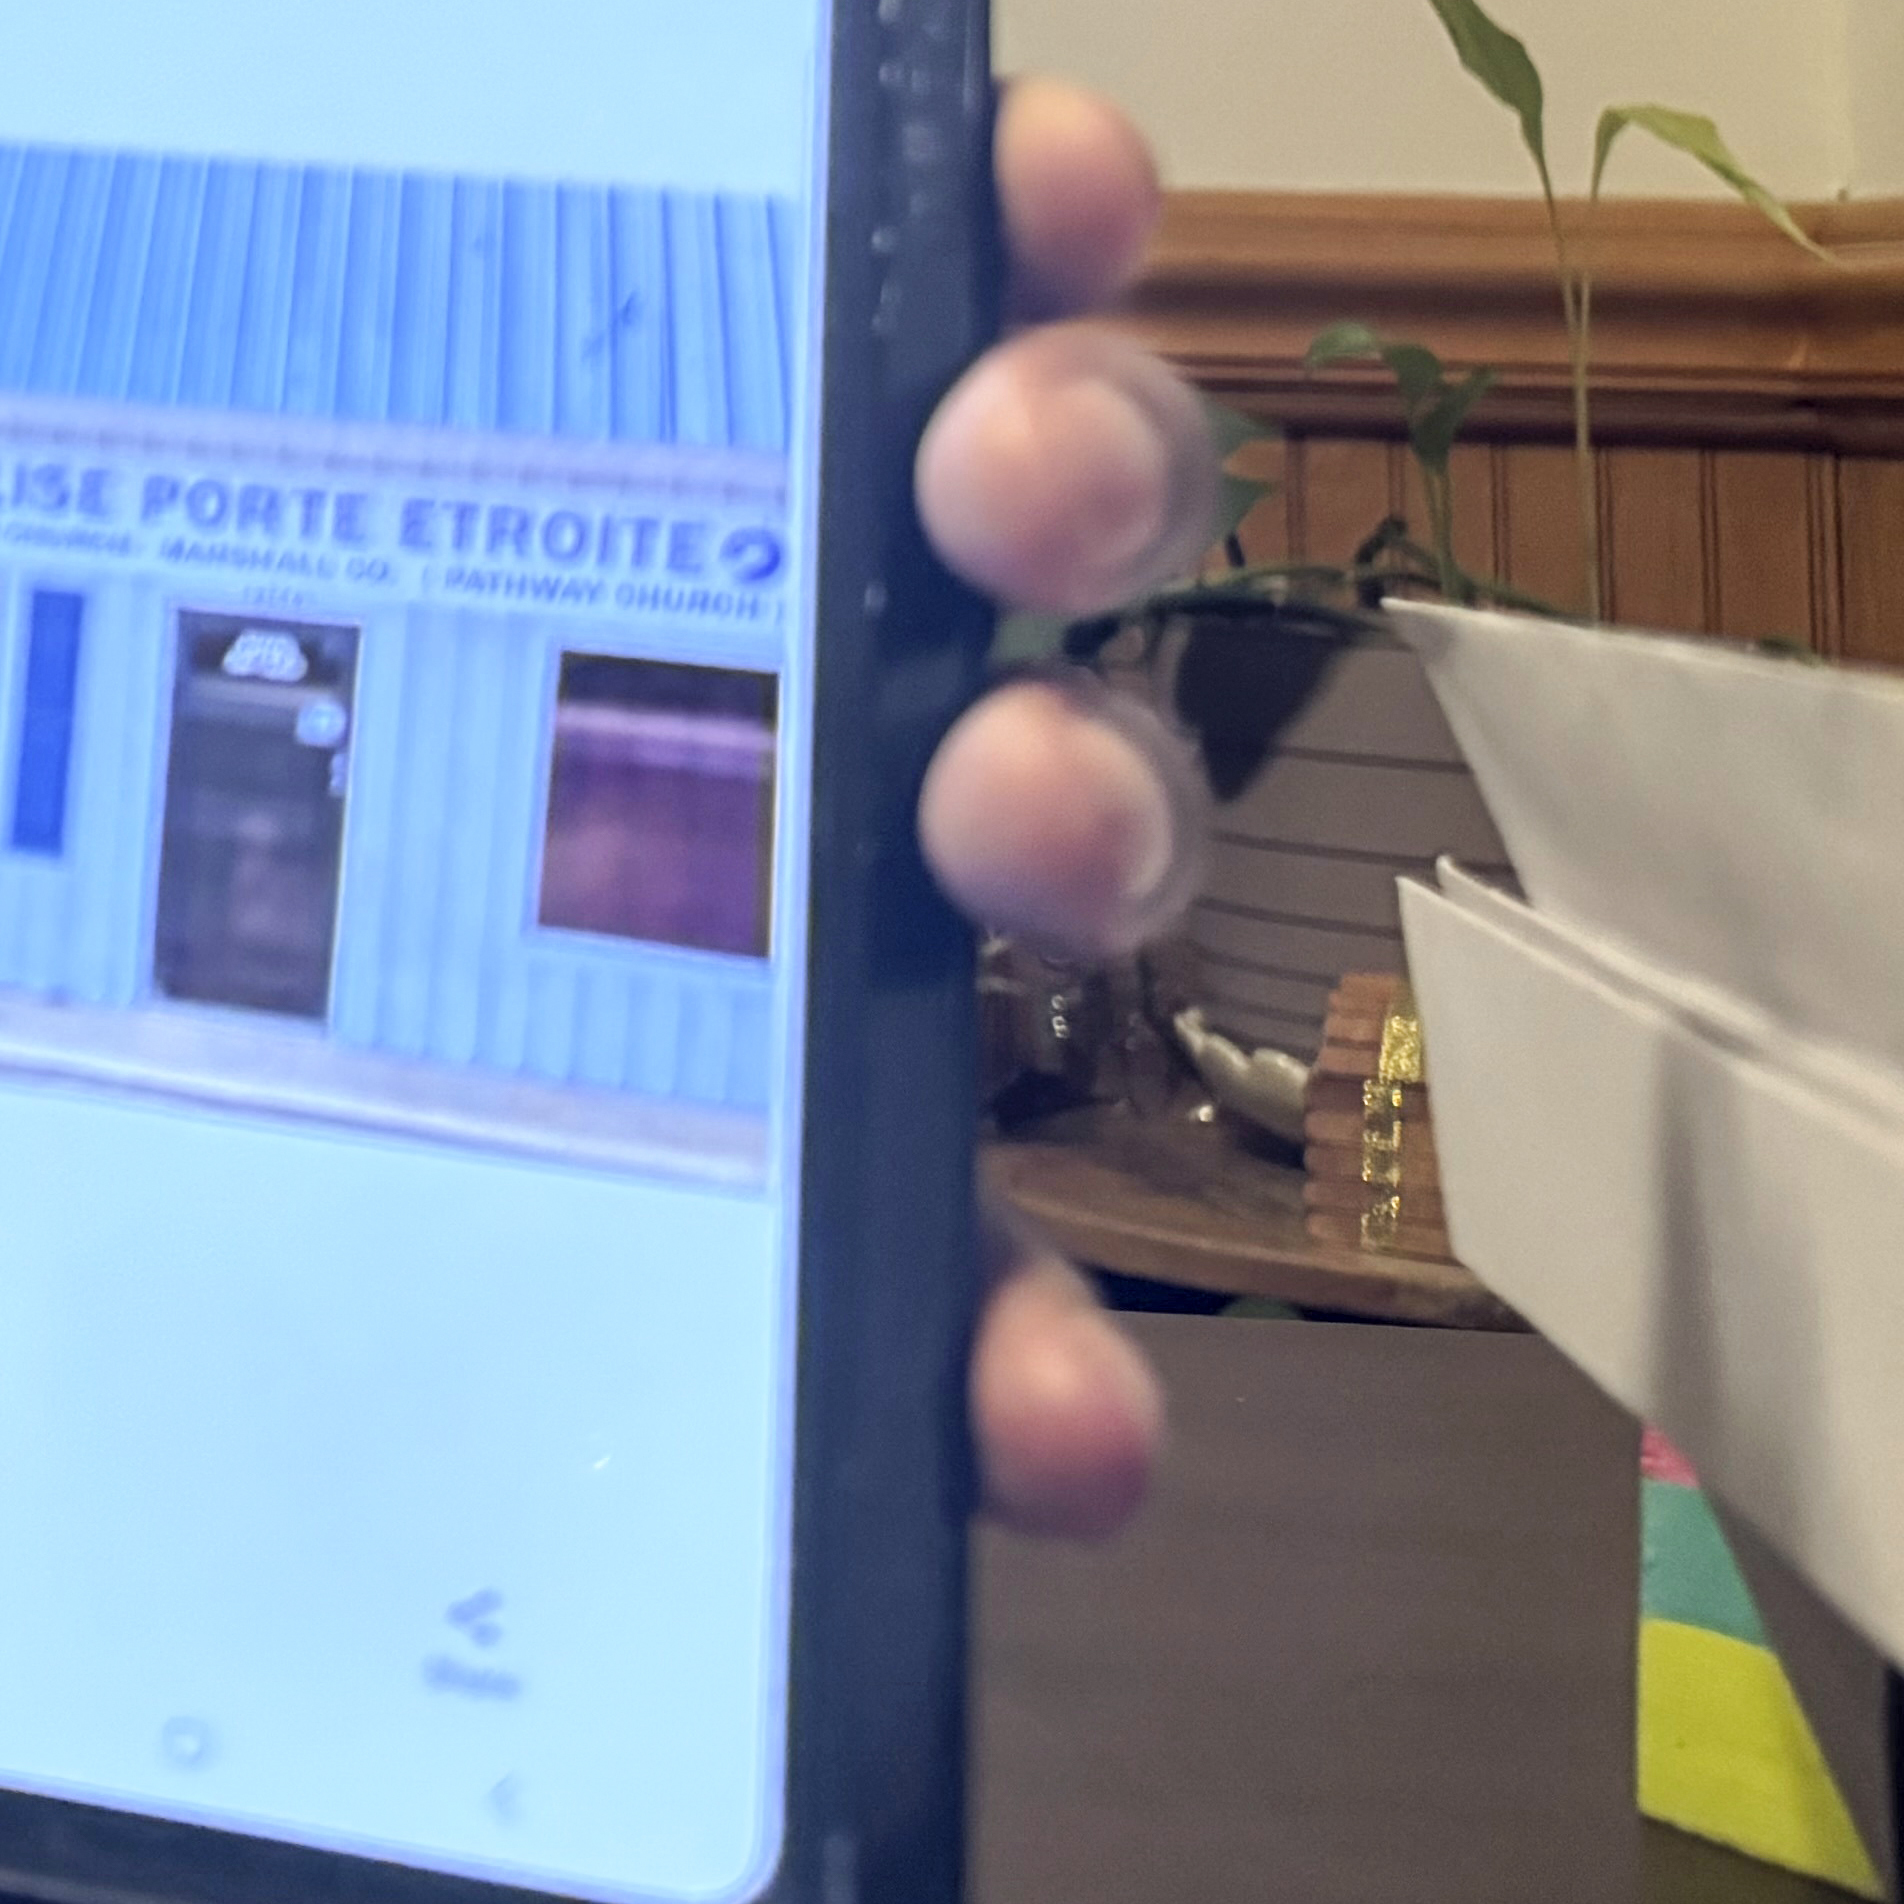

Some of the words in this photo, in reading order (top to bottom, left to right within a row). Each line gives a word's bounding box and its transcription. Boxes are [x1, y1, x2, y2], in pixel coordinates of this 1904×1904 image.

[141, 472, 370, 547] PORTE
[399, 497, 708, 575] ETROITE
[159, 536, 336, 584] MARSHALL
